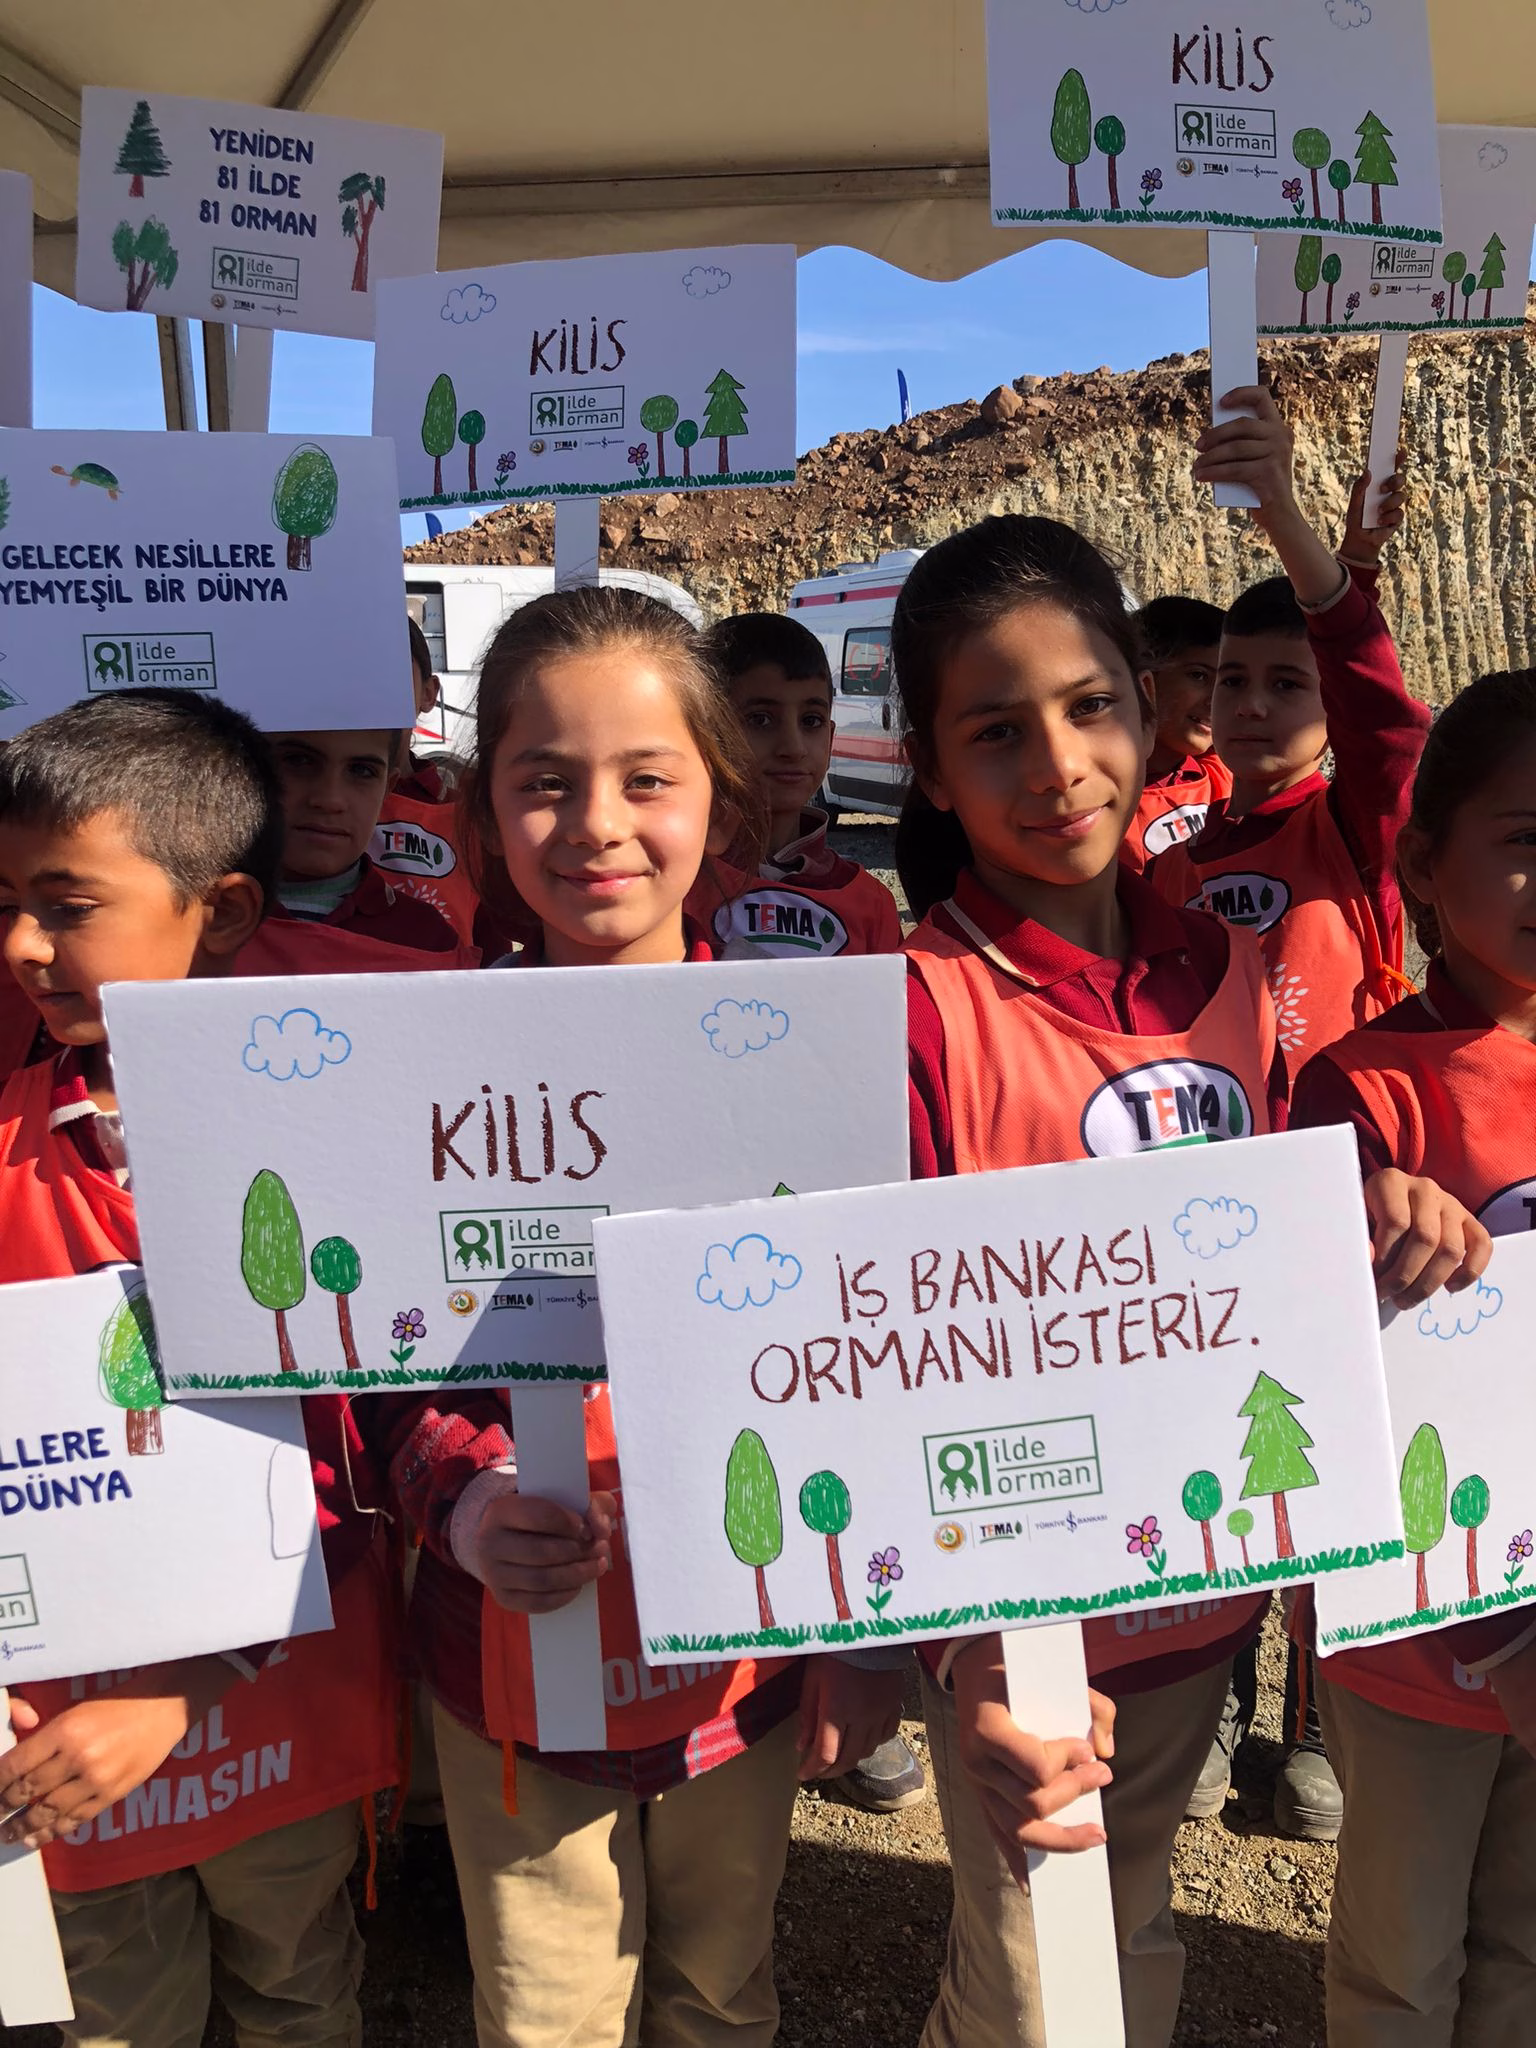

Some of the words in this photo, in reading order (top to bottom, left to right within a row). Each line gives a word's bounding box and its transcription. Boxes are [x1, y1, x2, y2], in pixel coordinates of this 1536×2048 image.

[1171, 25, 1275, 92] KİLİS
[1215, 113, 1247, 130] ilde
[209, 127, 314, 165] YENİDEN
[1216, 136, 1271, 150] orman
[217, 165, 238, 190] 81
[249, 164, 302, 199] İLDE
[199, 199, 220, 225] 81
[231, 204, 317, 238] ORMAN
[246, 258, 274, 274] ilde
[1397, 247, 1417, 259] ilde
[1396, 263, 1430, 273] orman
[246, 278, 293, 294] orman
[529, 316, 628, 376] KİLİS
[567, 395, 597, 409] ilde
[567, 412, 619, 426] orman
[2, 544, 123, 570] GELECEK
[136, 538, 276, 569] NESİLLERE
[0, 573, 134, 612] YEMYEŞİL
[145, 573, 187, 602] BİR
[197, 572, 289, 602] DÜNYA
[136, 641, 177, 659] ilde
[138, 665, 210, 682] orman
[382, 830, 431, 859] TEMA
[744, 903, 816, 938] TEMA
[431, 1082, 608, 1184] KİLİS
[509, 1218, 561, 1241] ilde
[836, 1253, 888, 1327] İŞ
[910, 1224, 1157, 1315] BANKASI
[492, 1293, 525, 1306] TEMA
[750, 1317, 1013, 1403] ORMANI
[993, 1436, 1046, 1463] ilde
[0, 1469, 133, 1516] DÜNYA
[997, 1465, 1092, 1494] orman
[980, 1522, 1014, 1538] TEMA
